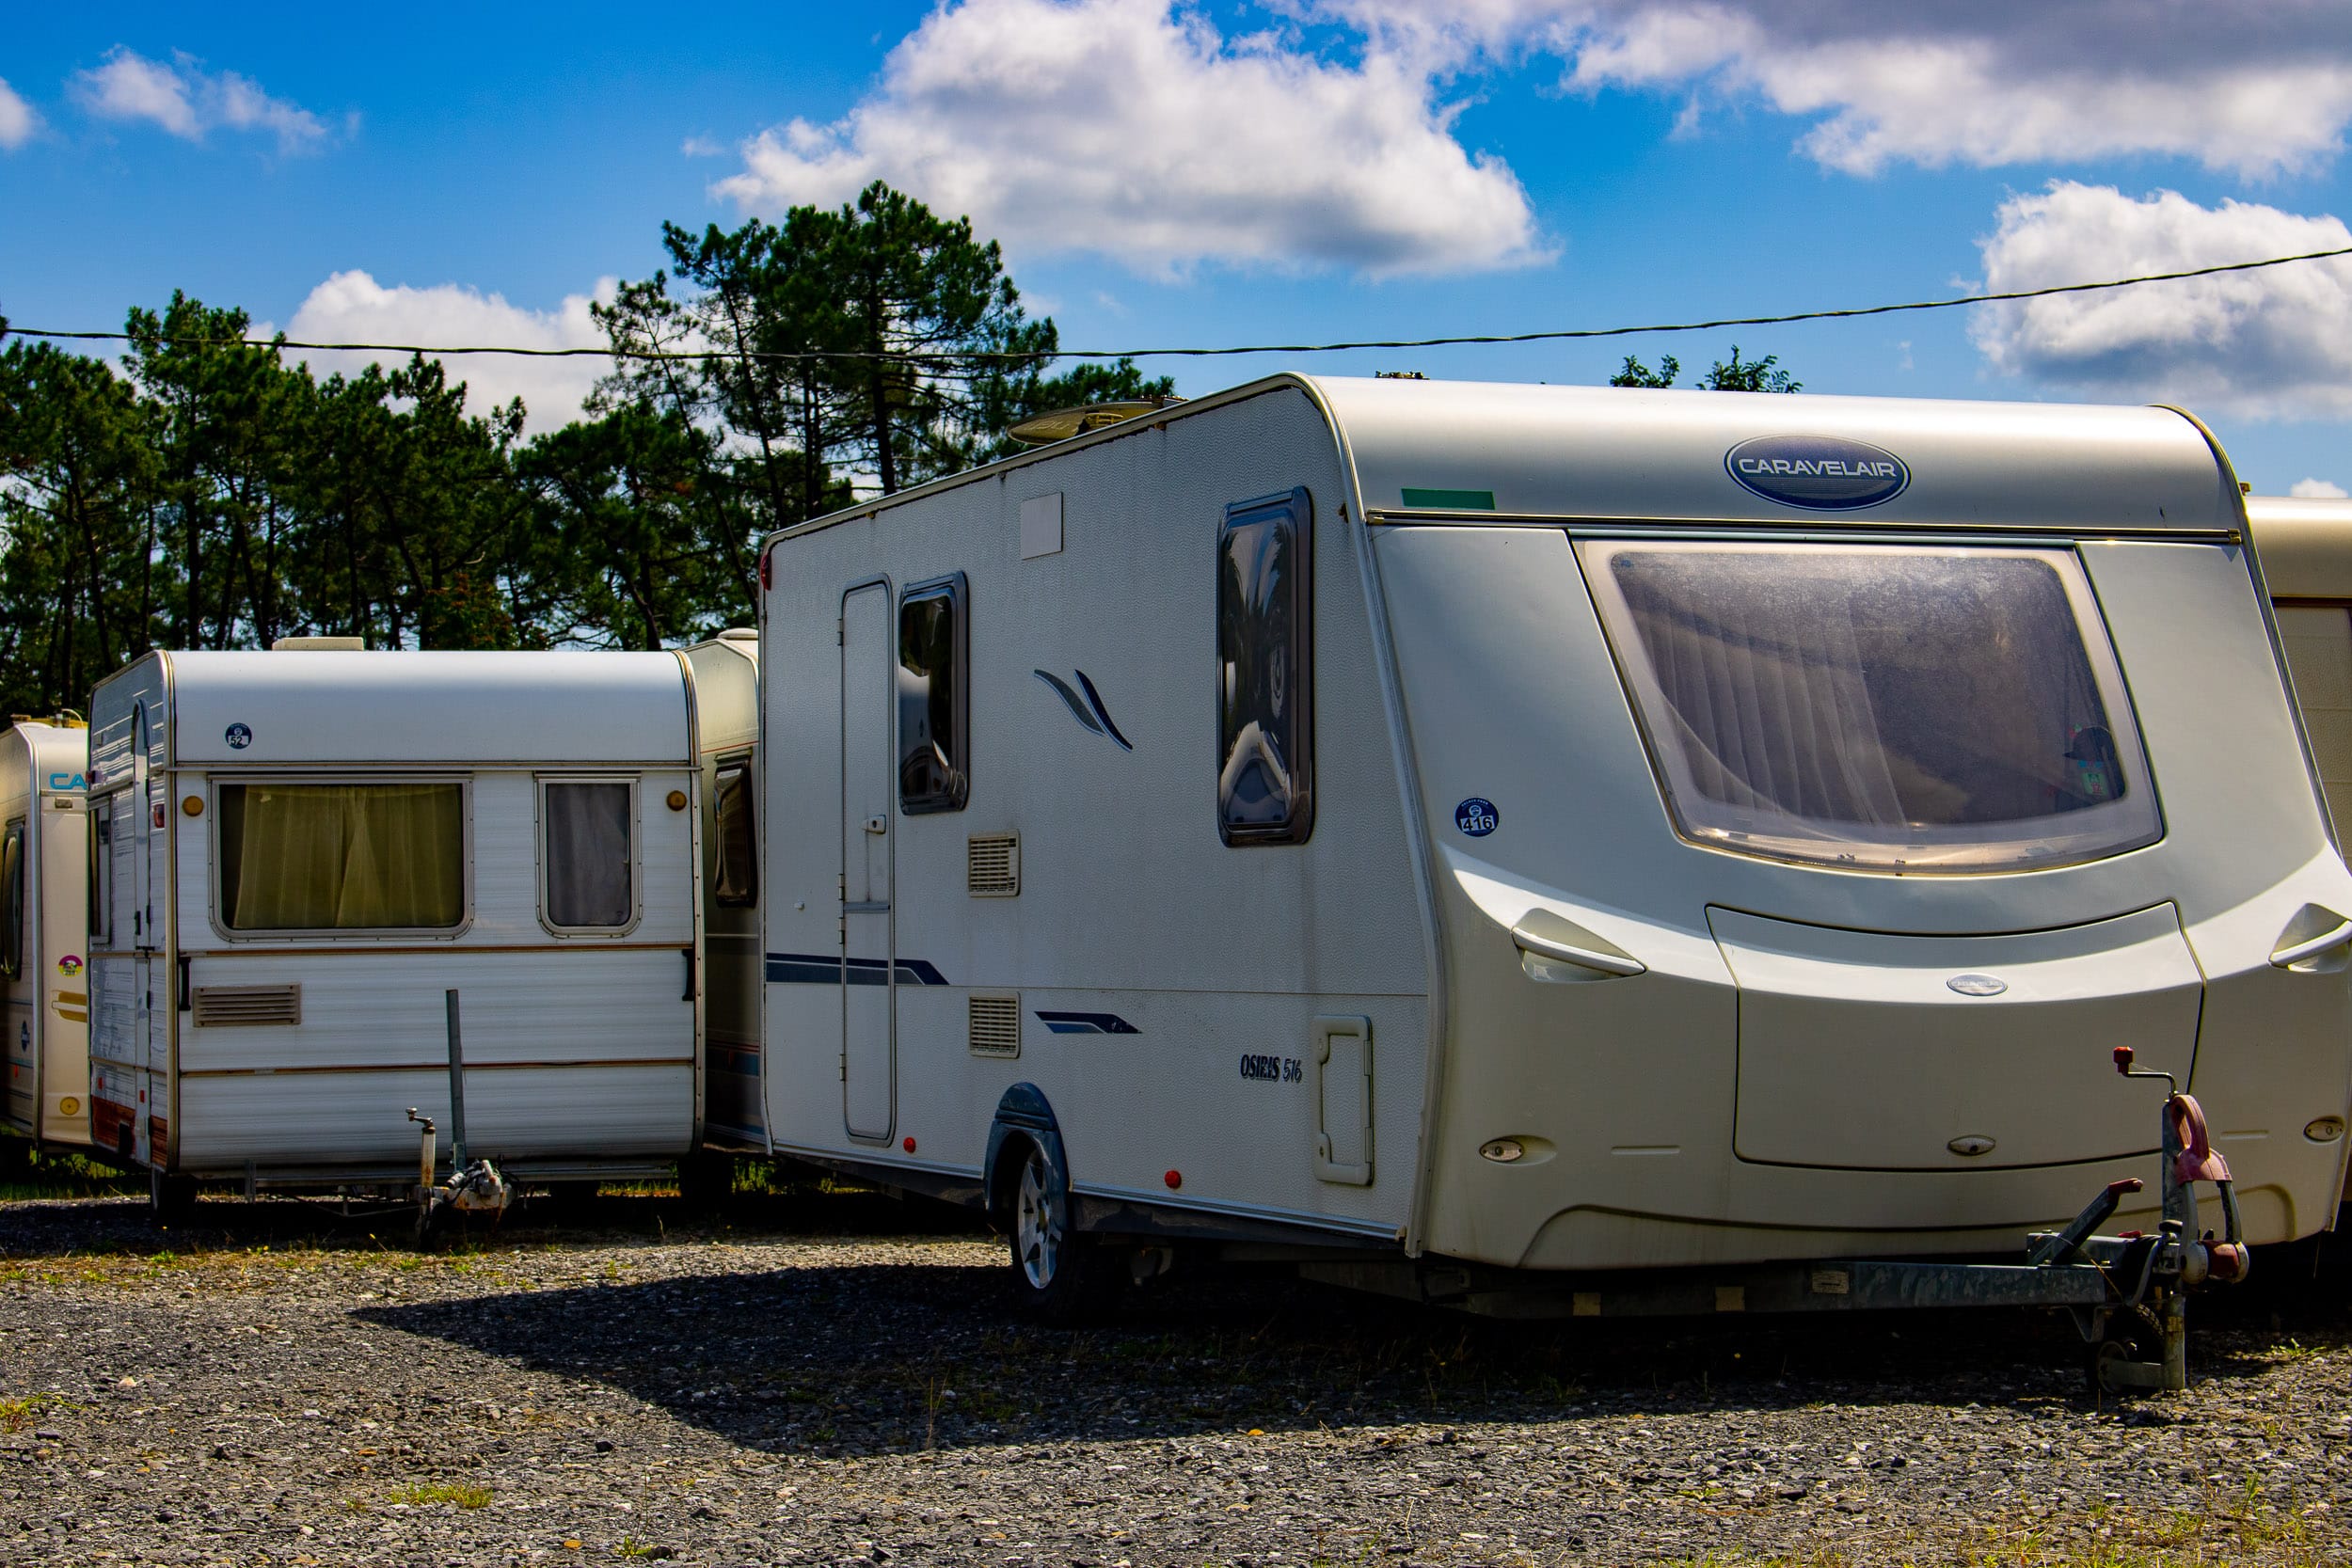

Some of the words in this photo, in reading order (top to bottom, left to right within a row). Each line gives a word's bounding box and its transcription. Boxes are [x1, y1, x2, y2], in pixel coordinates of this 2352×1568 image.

[1738, 458, 1897, 478] CARAVELAIR
[230, 736, 243, 746] 52
[1463, 816, 1493, 832] 416
[1240, 1053, 1280, 1082] OSIRIS
[1282, 1057, 1303, 1084] 516
